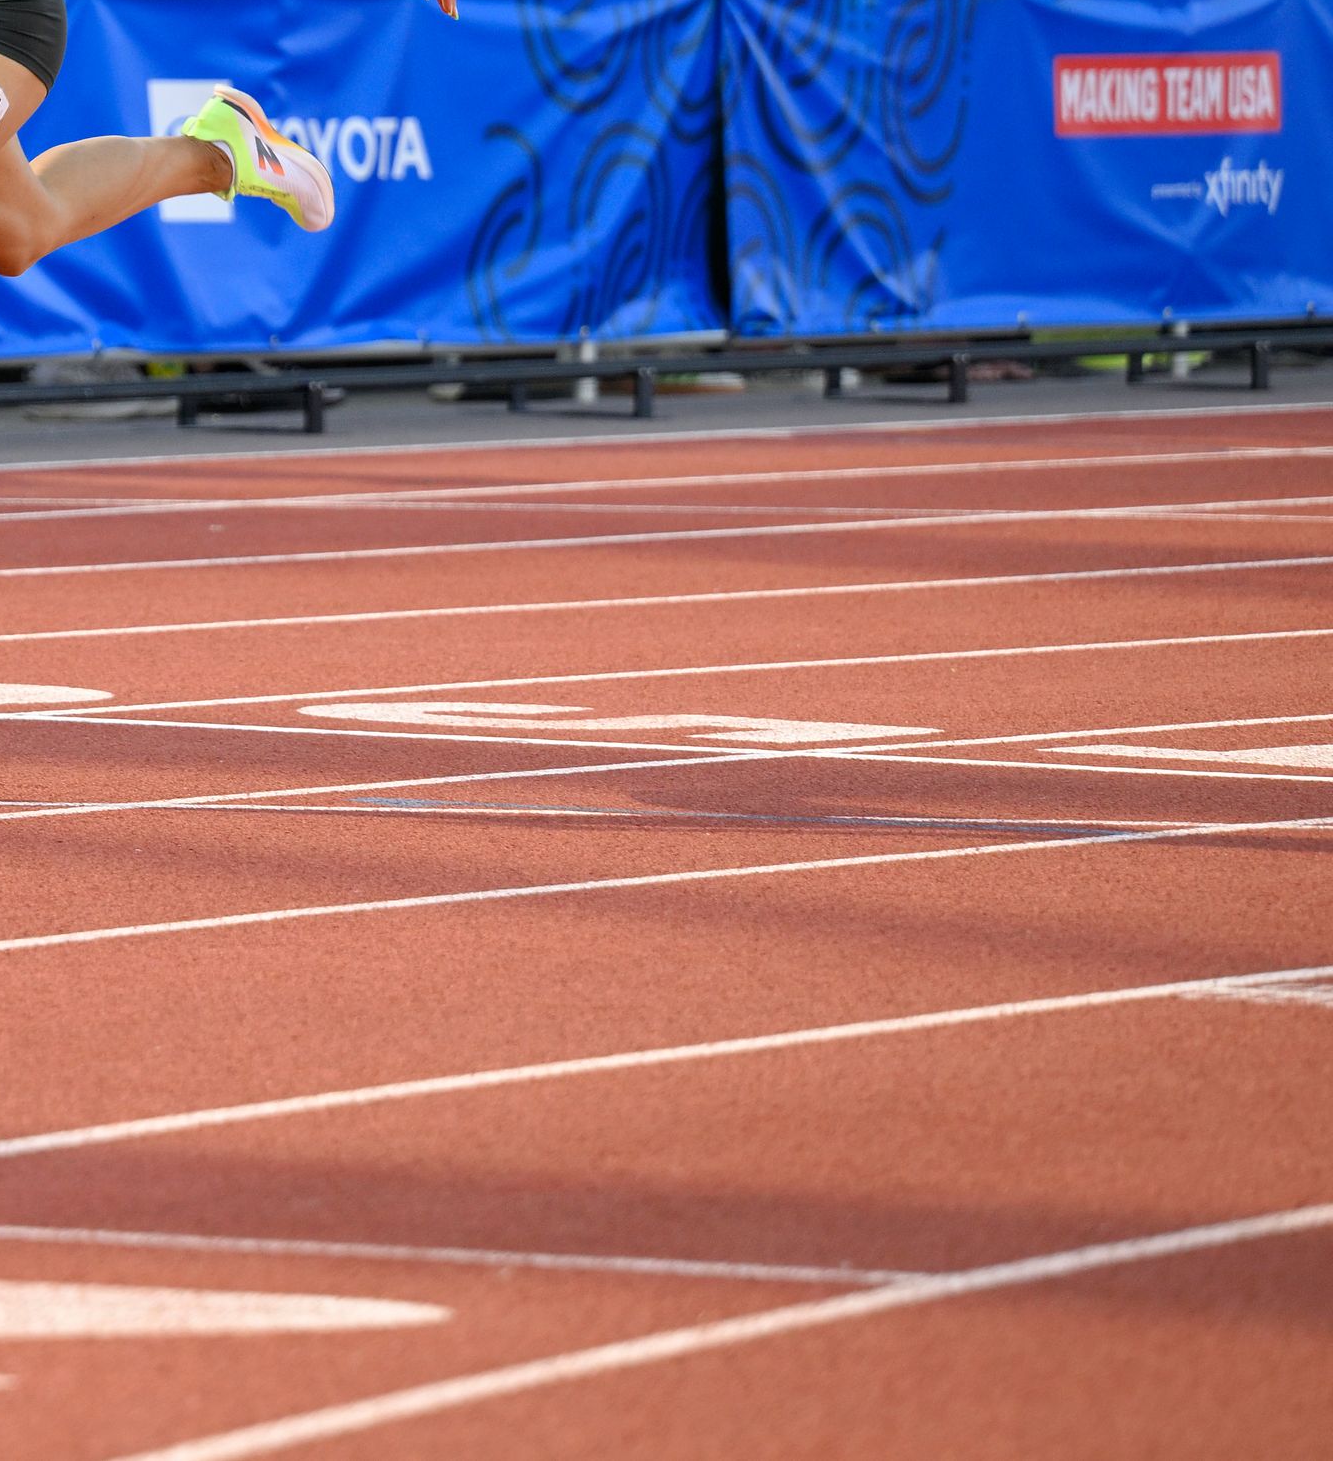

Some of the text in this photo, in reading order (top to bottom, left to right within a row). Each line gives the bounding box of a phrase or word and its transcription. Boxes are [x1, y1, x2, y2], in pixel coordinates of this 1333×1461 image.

[1059, 64, 1277, 124] MAKING TEAM USA
[269, 116, 432, 183] YOTA
[1203, 155, 1285, 218] xfinity
